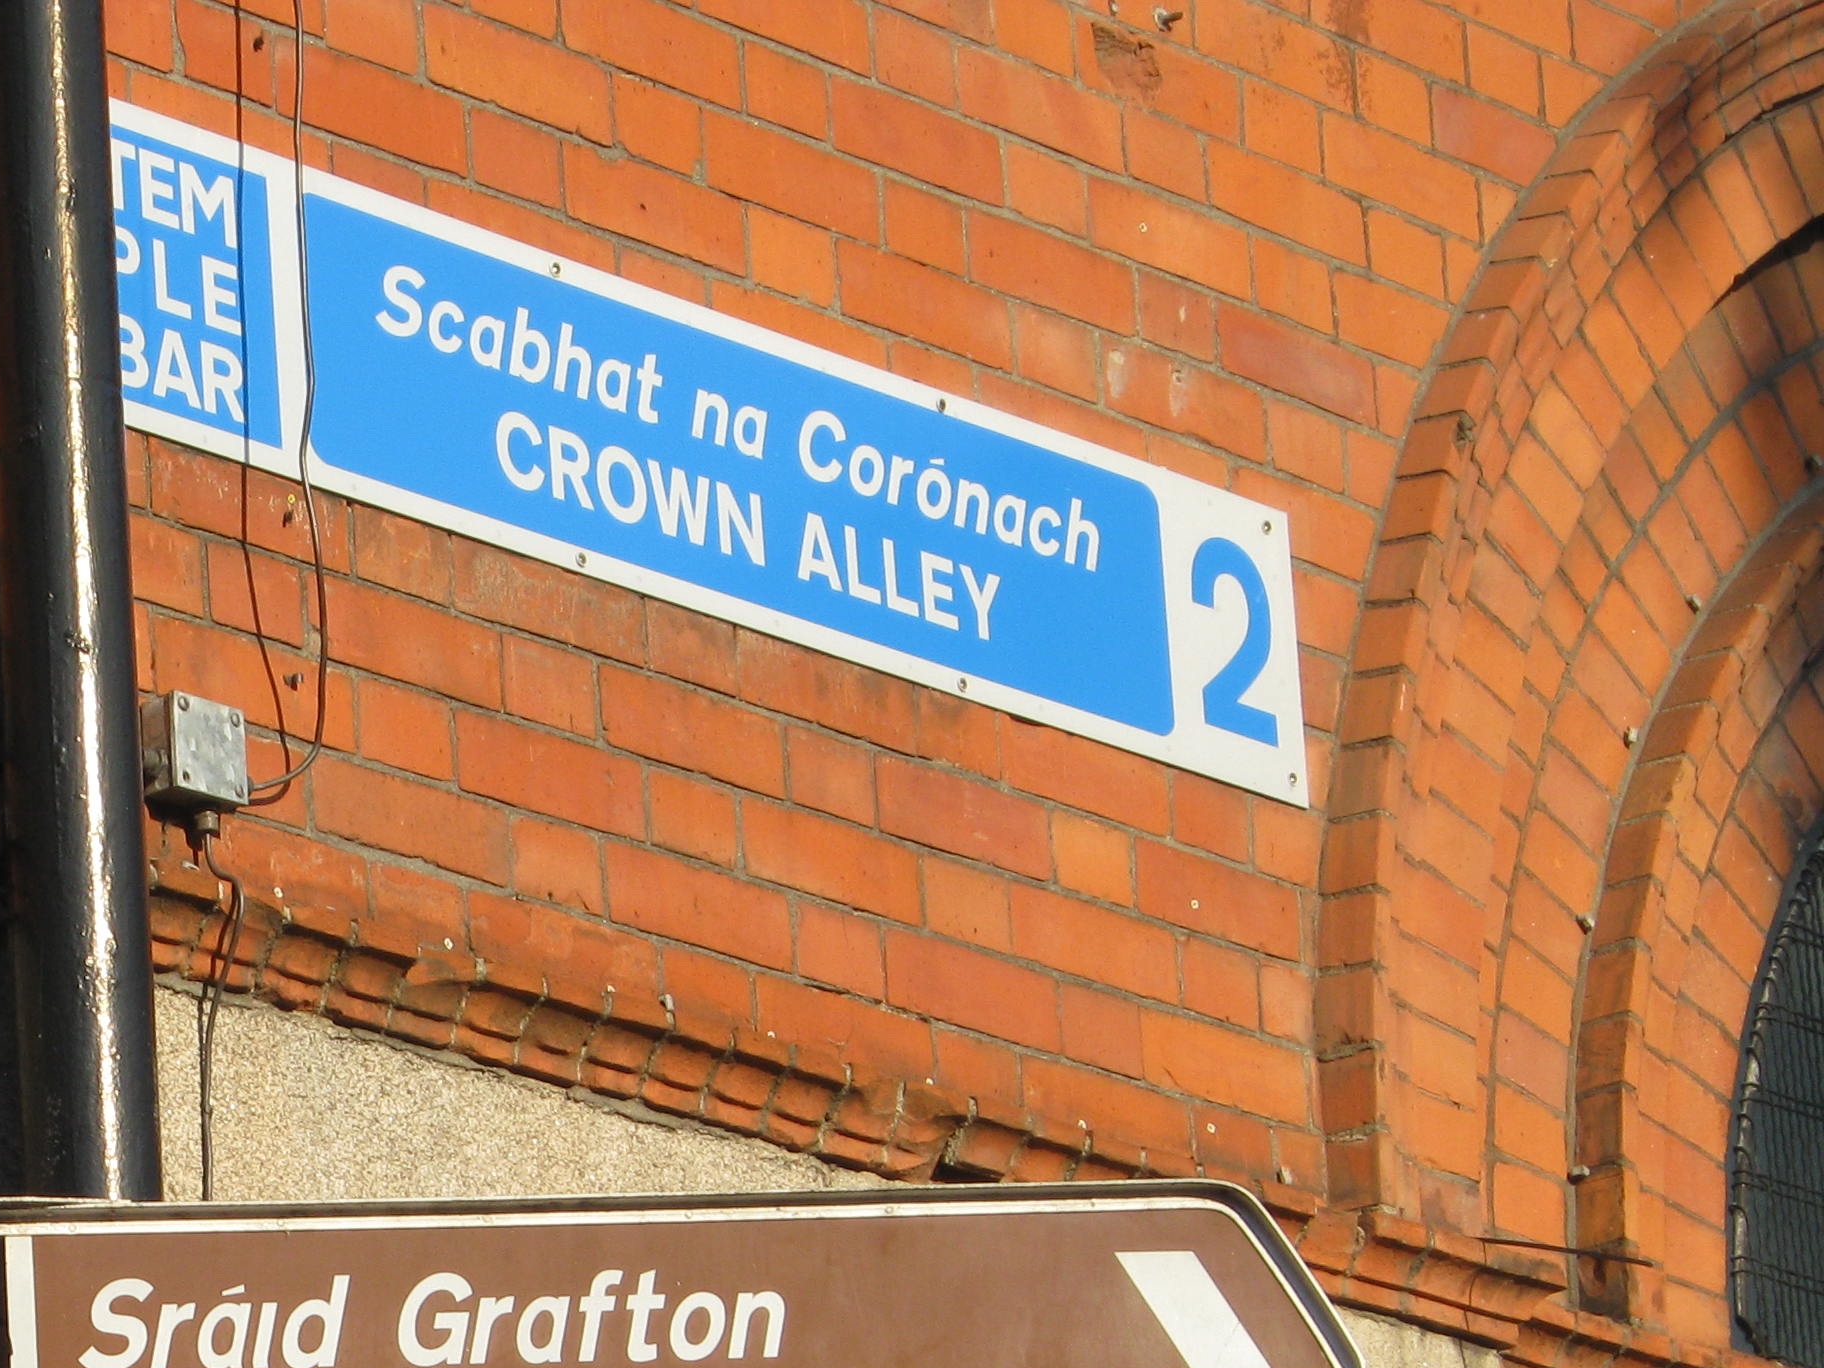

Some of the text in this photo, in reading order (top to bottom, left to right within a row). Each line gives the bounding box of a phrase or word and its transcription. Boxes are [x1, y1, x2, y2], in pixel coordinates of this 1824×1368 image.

[376, 265, 1100, 572] Scabhat na Corónach
[495, 411, 1000, 640] CROWN ALLEY
[1191, 537, 1278, 748] 2
[397, 1269, 786, 1367] Grafton
